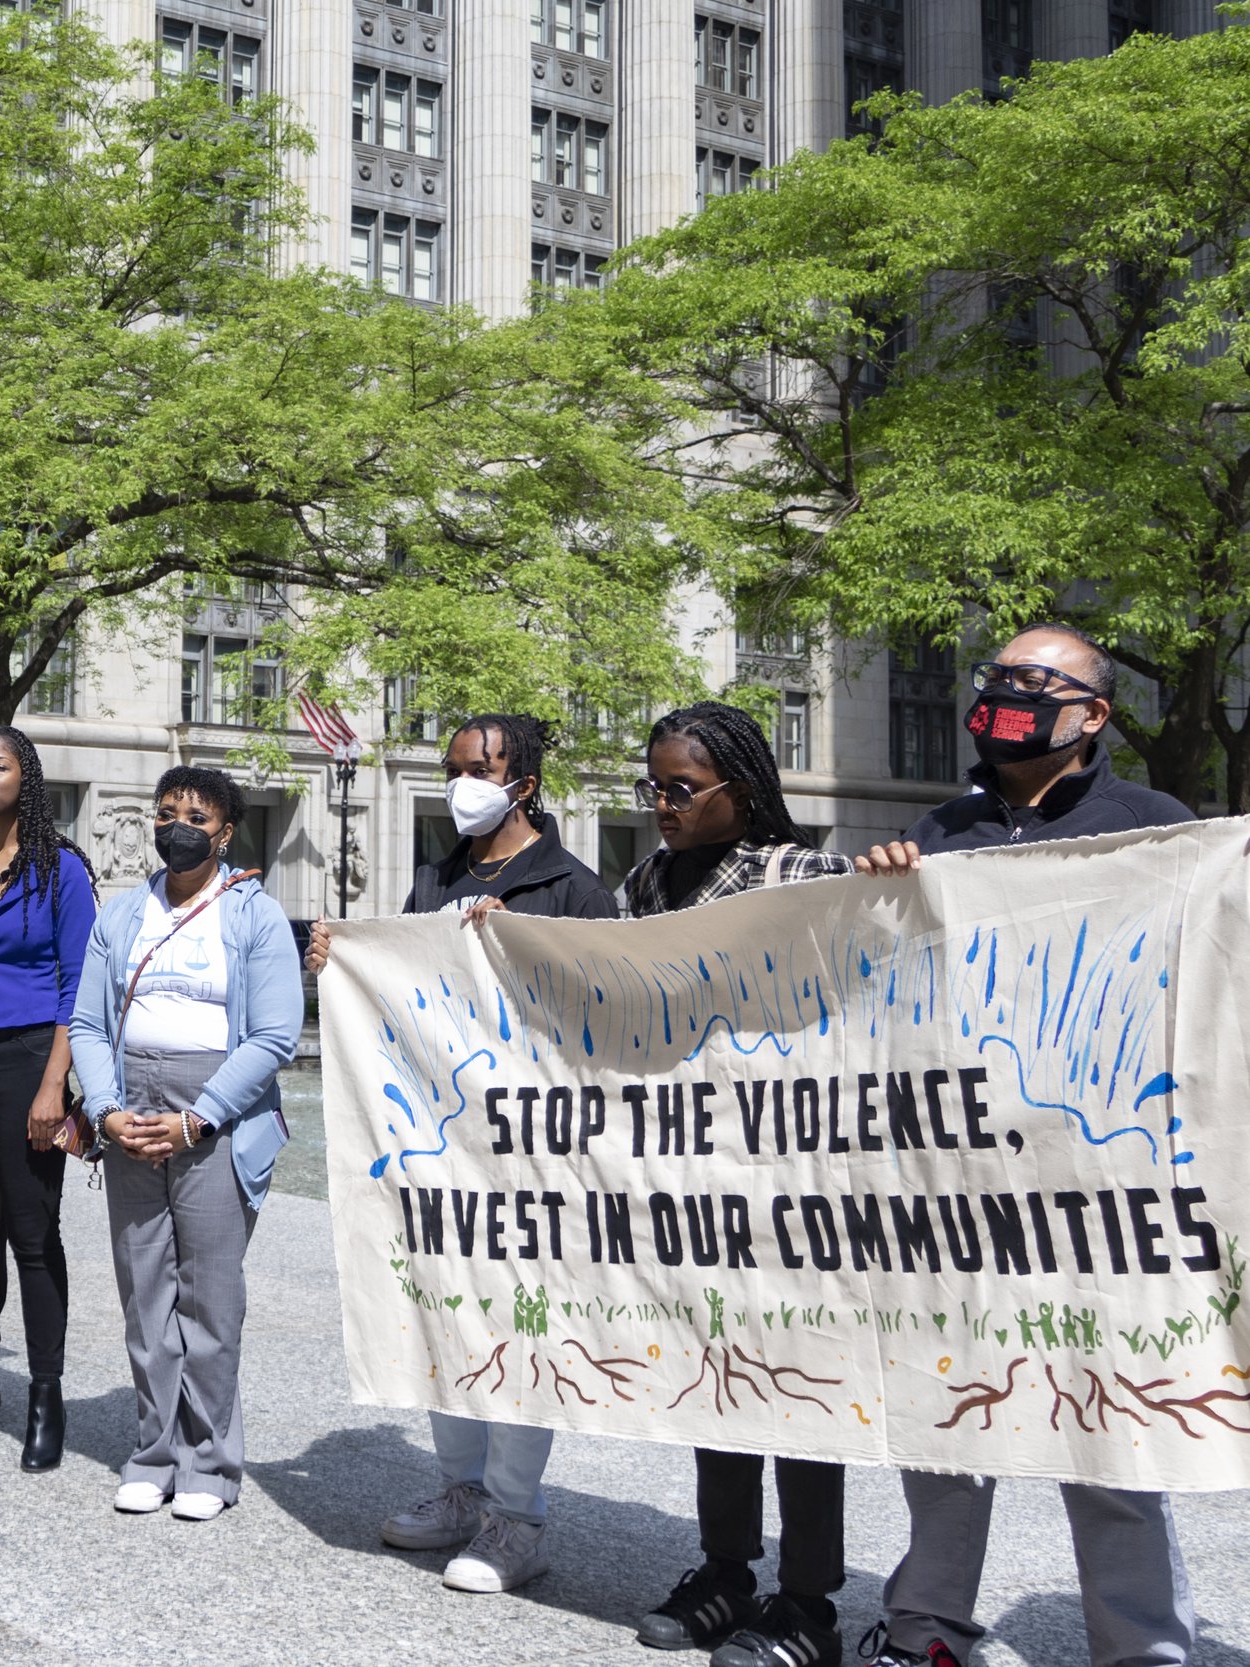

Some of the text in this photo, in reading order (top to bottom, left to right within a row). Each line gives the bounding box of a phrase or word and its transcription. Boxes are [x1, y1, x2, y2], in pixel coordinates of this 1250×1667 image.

[991, 728, 1025, 741] SCHOOL
[993, 719, 1036, 733] FREEDOM
[485, 1067, 1024, 1157] STOP THE VIOLENCE,
[399, 1186, 1220, 1275] INVEST IN OUR COMMUNITIES
